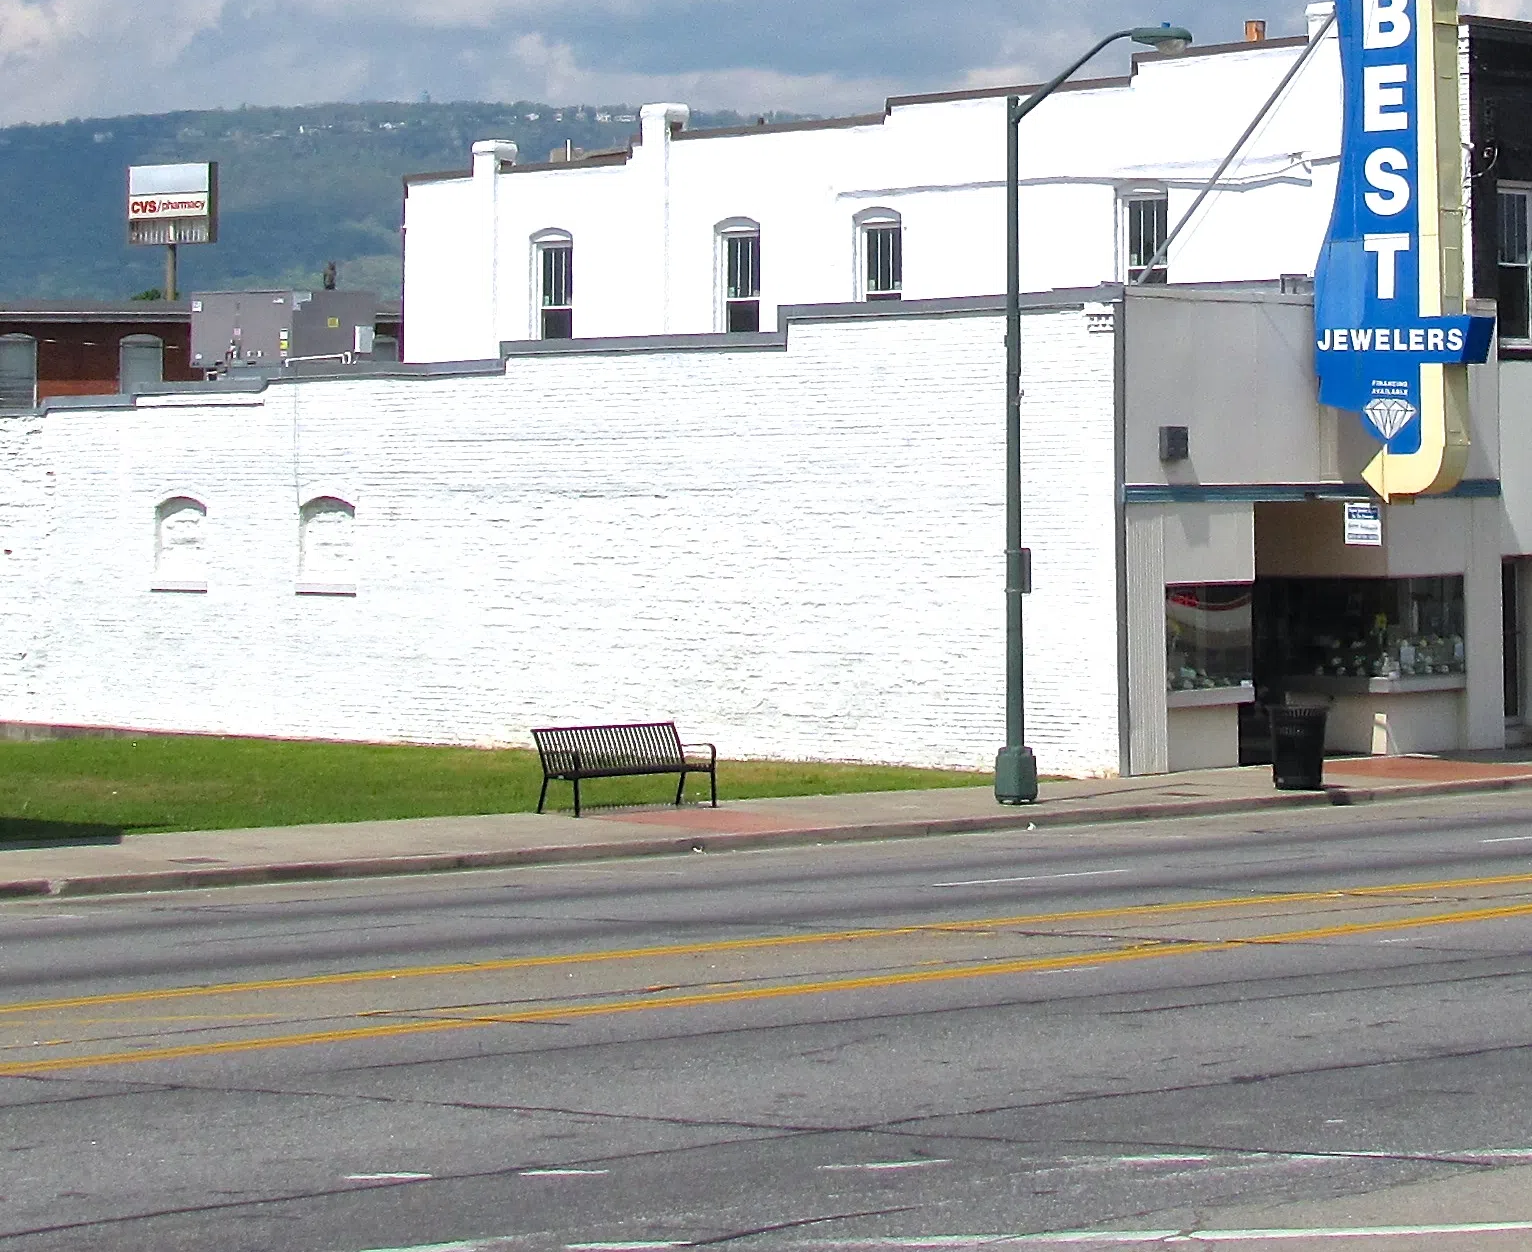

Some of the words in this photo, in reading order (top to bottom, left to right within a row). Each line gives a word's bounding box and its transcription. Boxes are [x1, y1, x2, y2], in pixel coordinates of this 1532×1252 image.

[1317, 328, 1463, 352] JEWELERS
[1371, 379, 1409, 388] FINANCING
[1371, 388, 1409, 396] AVAILABLE
